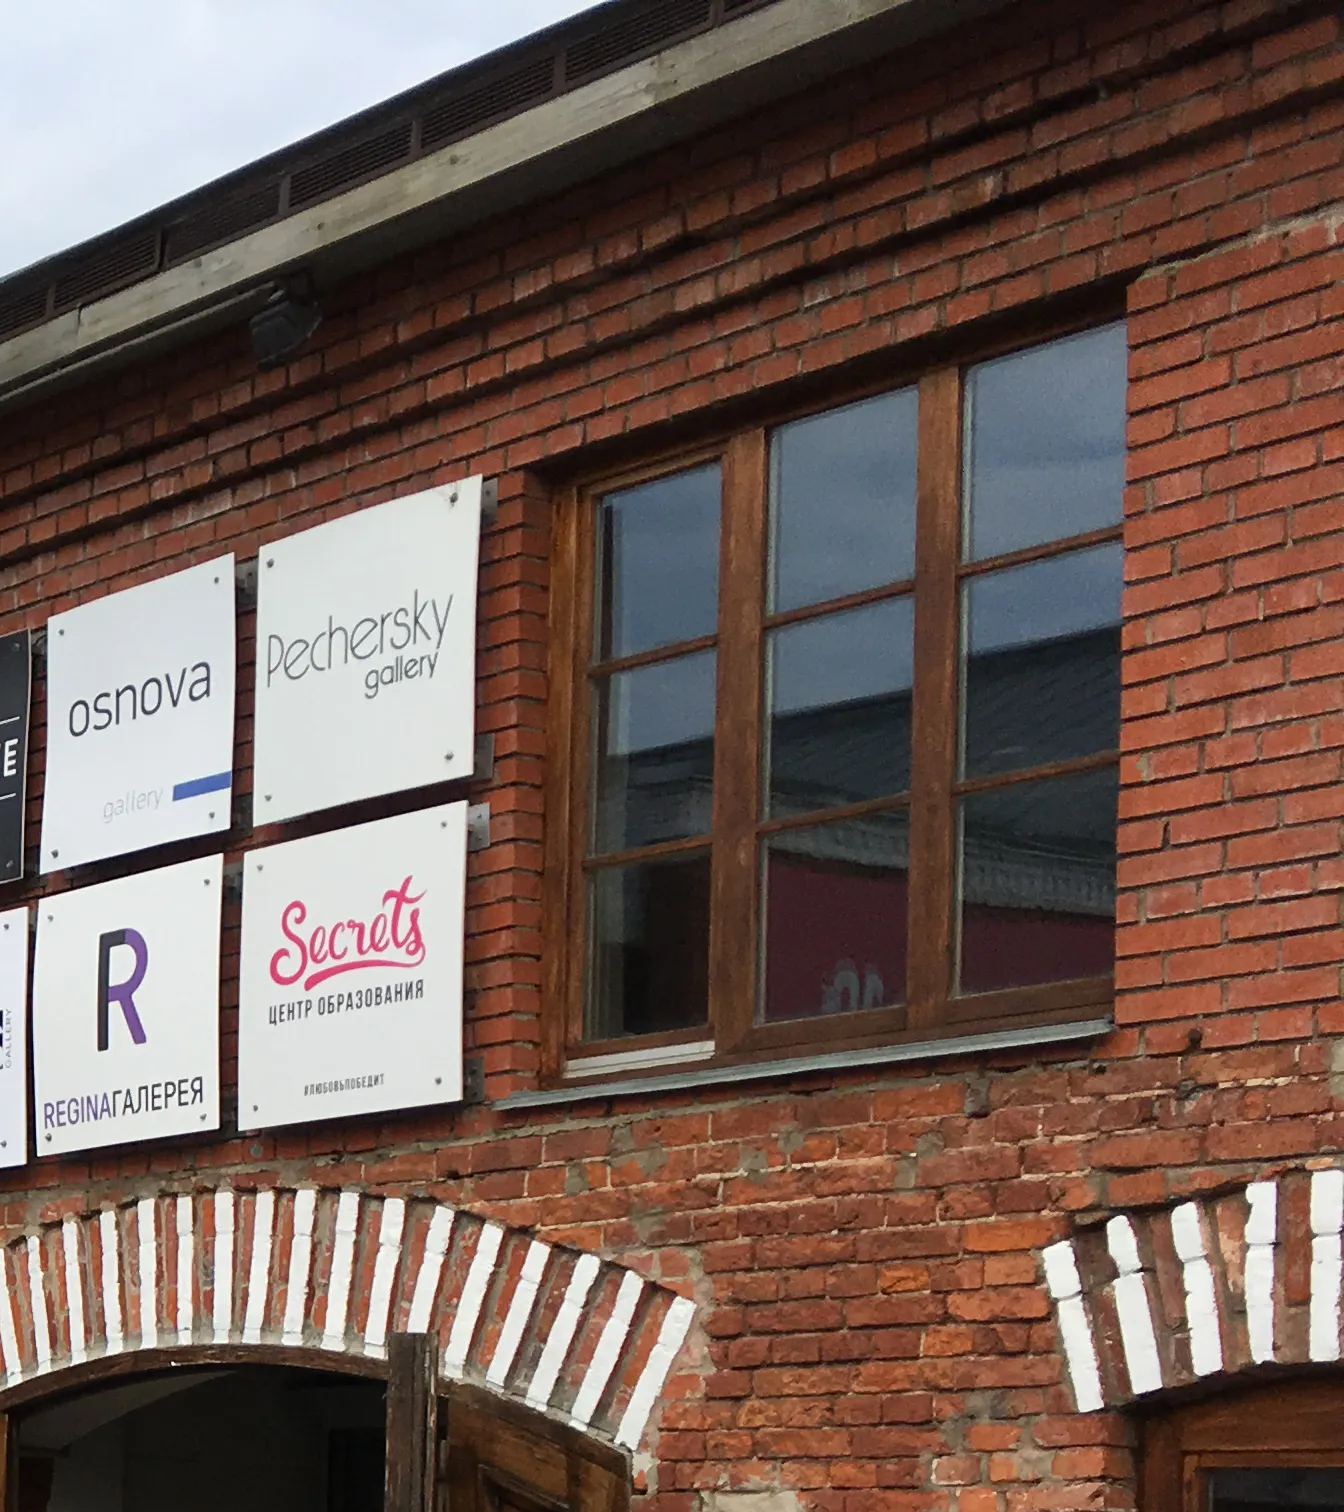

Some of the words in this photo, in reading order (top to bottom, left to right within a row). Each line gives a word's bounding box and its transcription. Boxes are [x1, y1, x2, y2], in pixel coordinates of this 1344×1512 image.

[267, 588, 454, 689] Pechersky
[69, 661, 211, 737] osnova
[364, 651, 439, 699] gallery
[102, 787, 164, 824] gallery
[269, 874, 427, 991] Secrets
[97, 927, 149, 1053] R
[268, 998, 313, 1026] ЦЕНТР
[317, 979, 424, 1017] ОБРАЗОВАНИЯ
[5, 1008, 13, 1069] GALLERY
